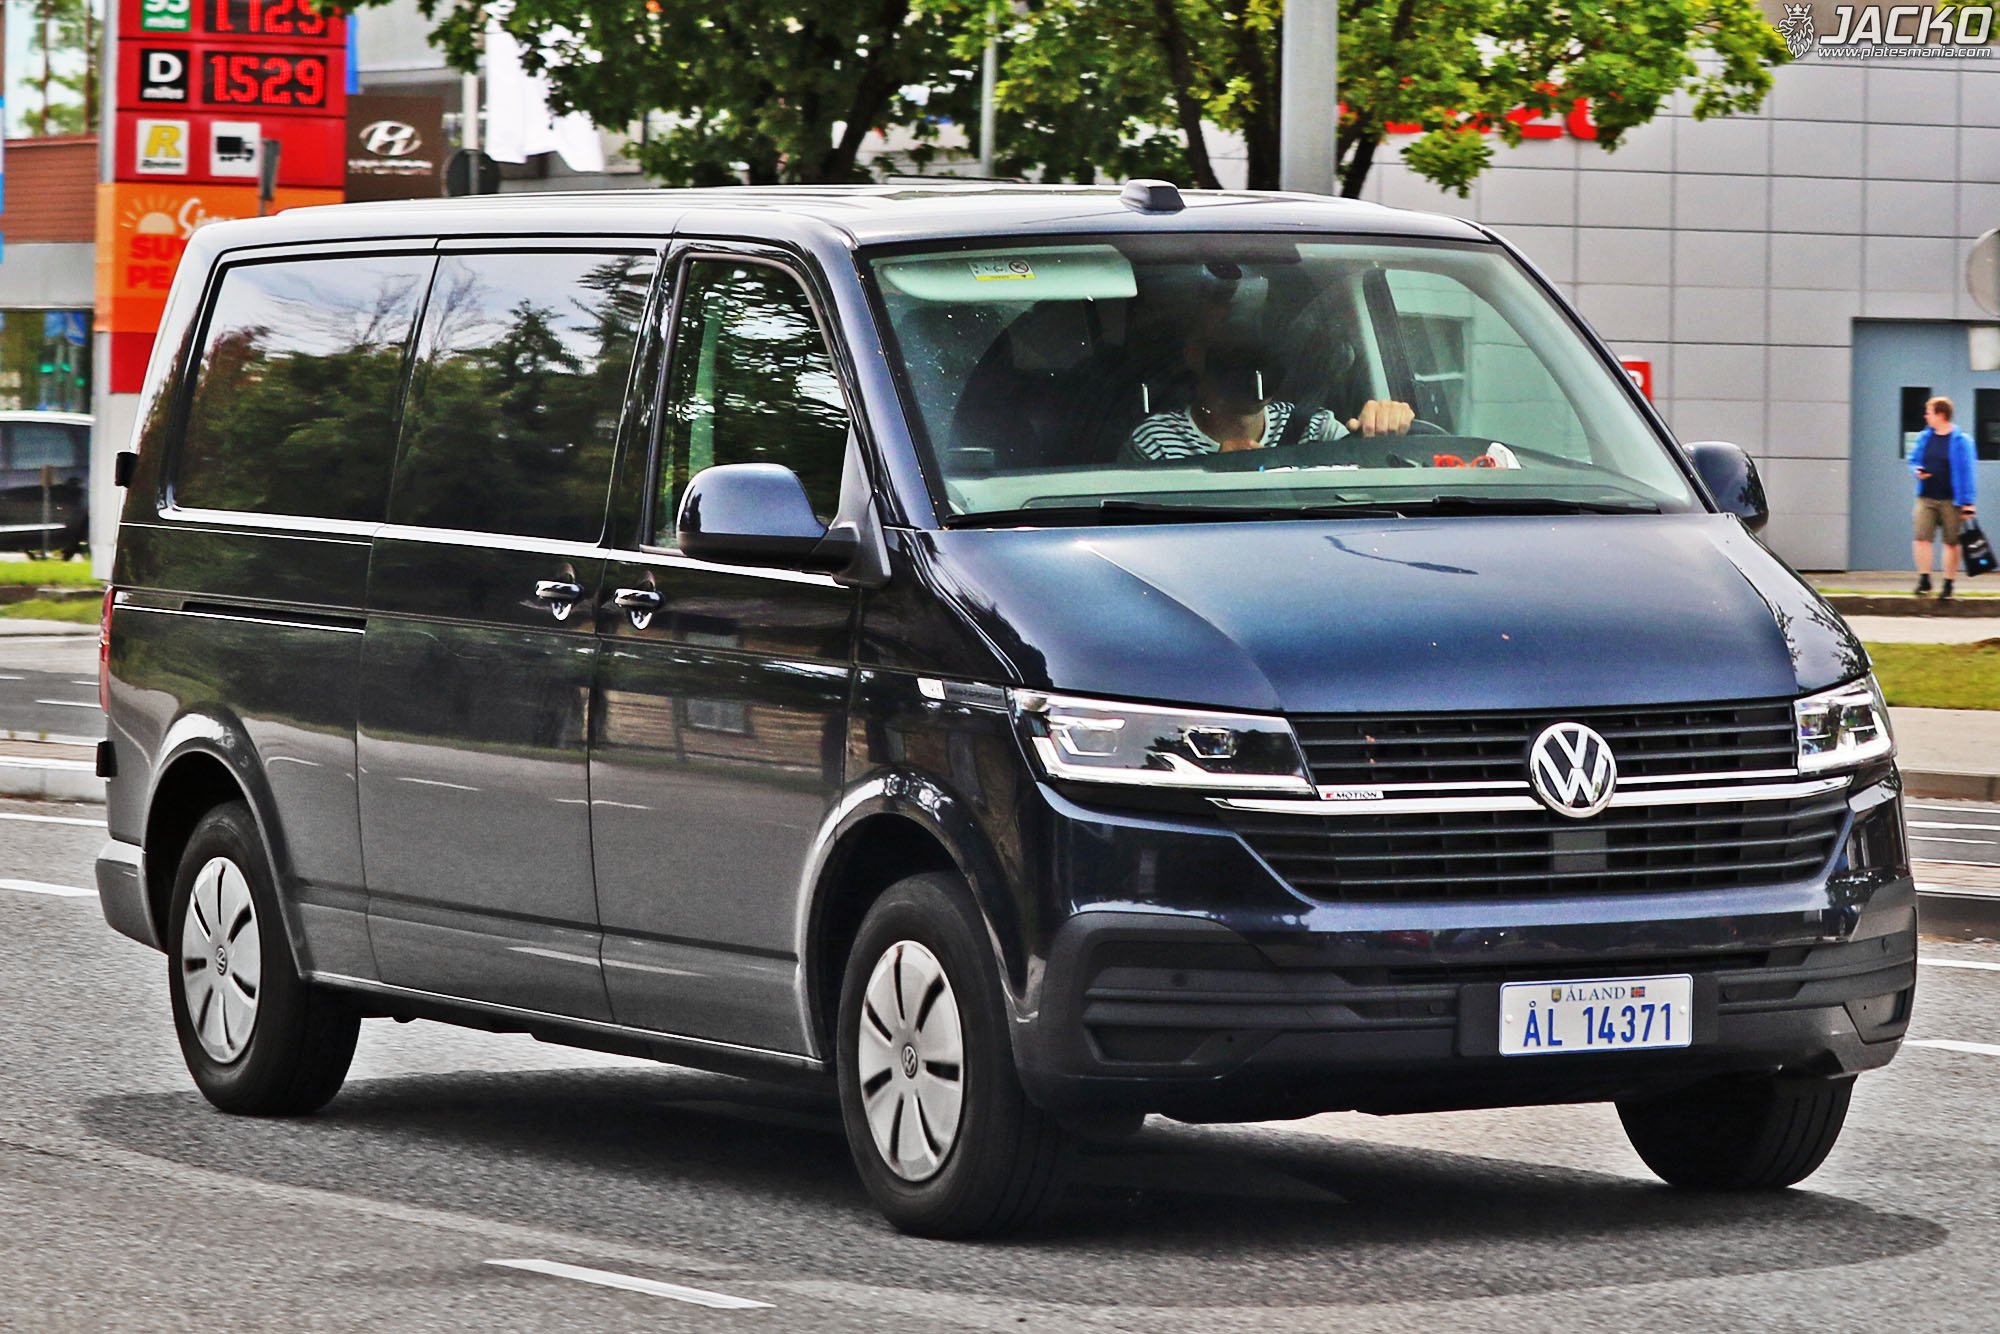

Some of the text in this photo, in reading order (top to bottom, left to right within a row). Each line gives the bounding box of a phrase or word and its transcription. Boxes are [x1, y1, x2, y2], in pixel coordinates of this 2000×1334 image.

[148, 52, 183, 83] D
[210, 55, 325, 105] 1529
[145, 125, 182, 158] R
[1565, 985, 1626, 1001] ÅLAND
[1523, 1000, 1672, 1047] ÅL 14371
